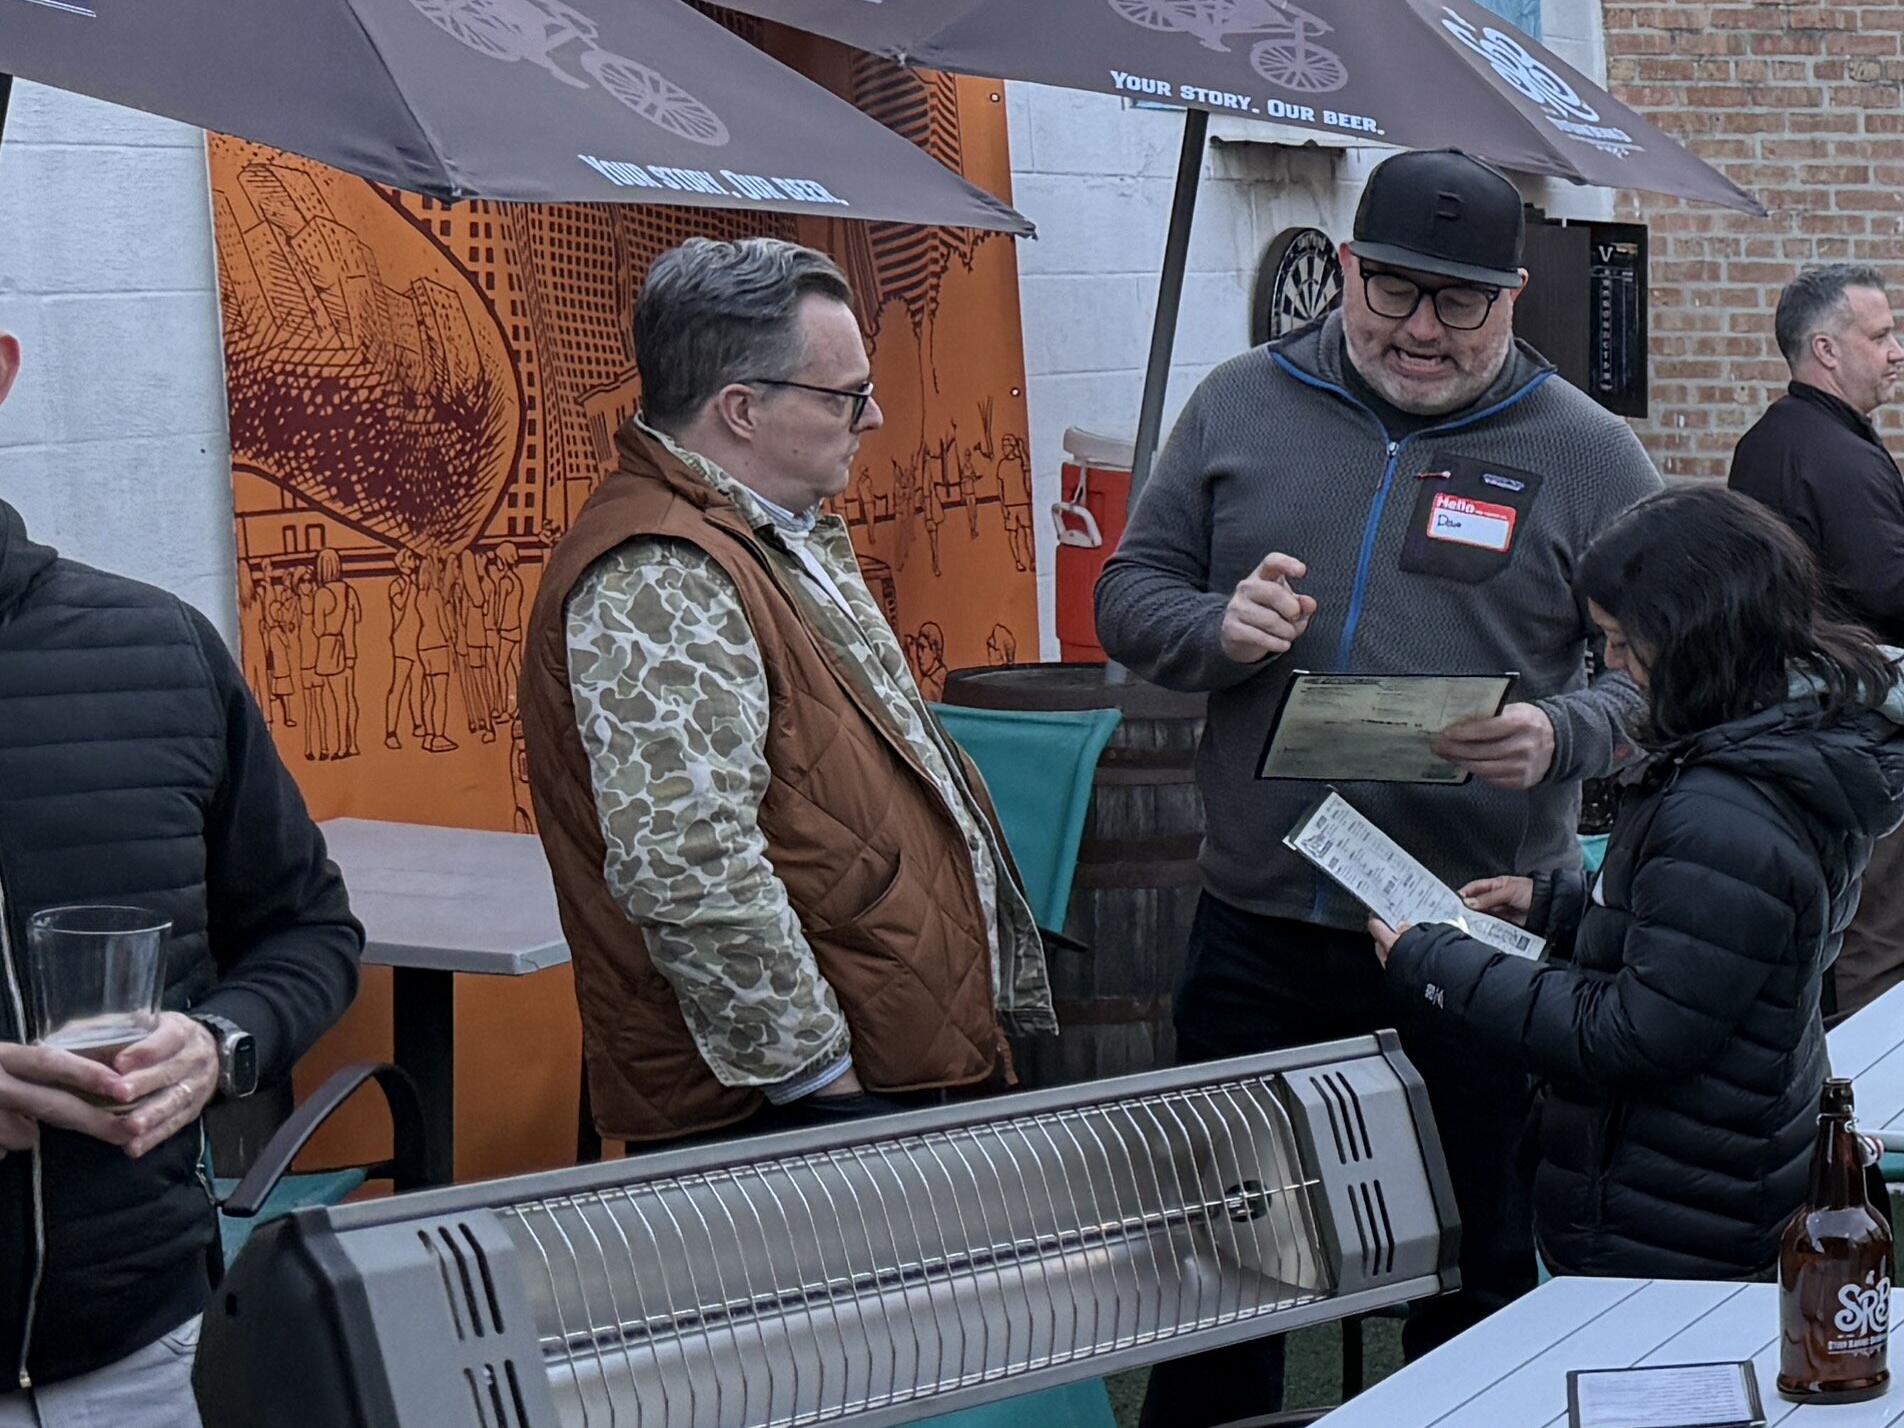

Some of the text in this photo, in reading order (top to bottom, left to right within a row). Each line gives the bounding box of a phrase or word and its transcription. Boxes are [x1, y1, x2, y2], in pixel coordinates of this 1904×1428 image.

[1110, 70, 1386, 136] YOUR STORY. OUR BEER.
[578, 154, 663, 188] YOUR
[720, 169, 789, 201] OUR
